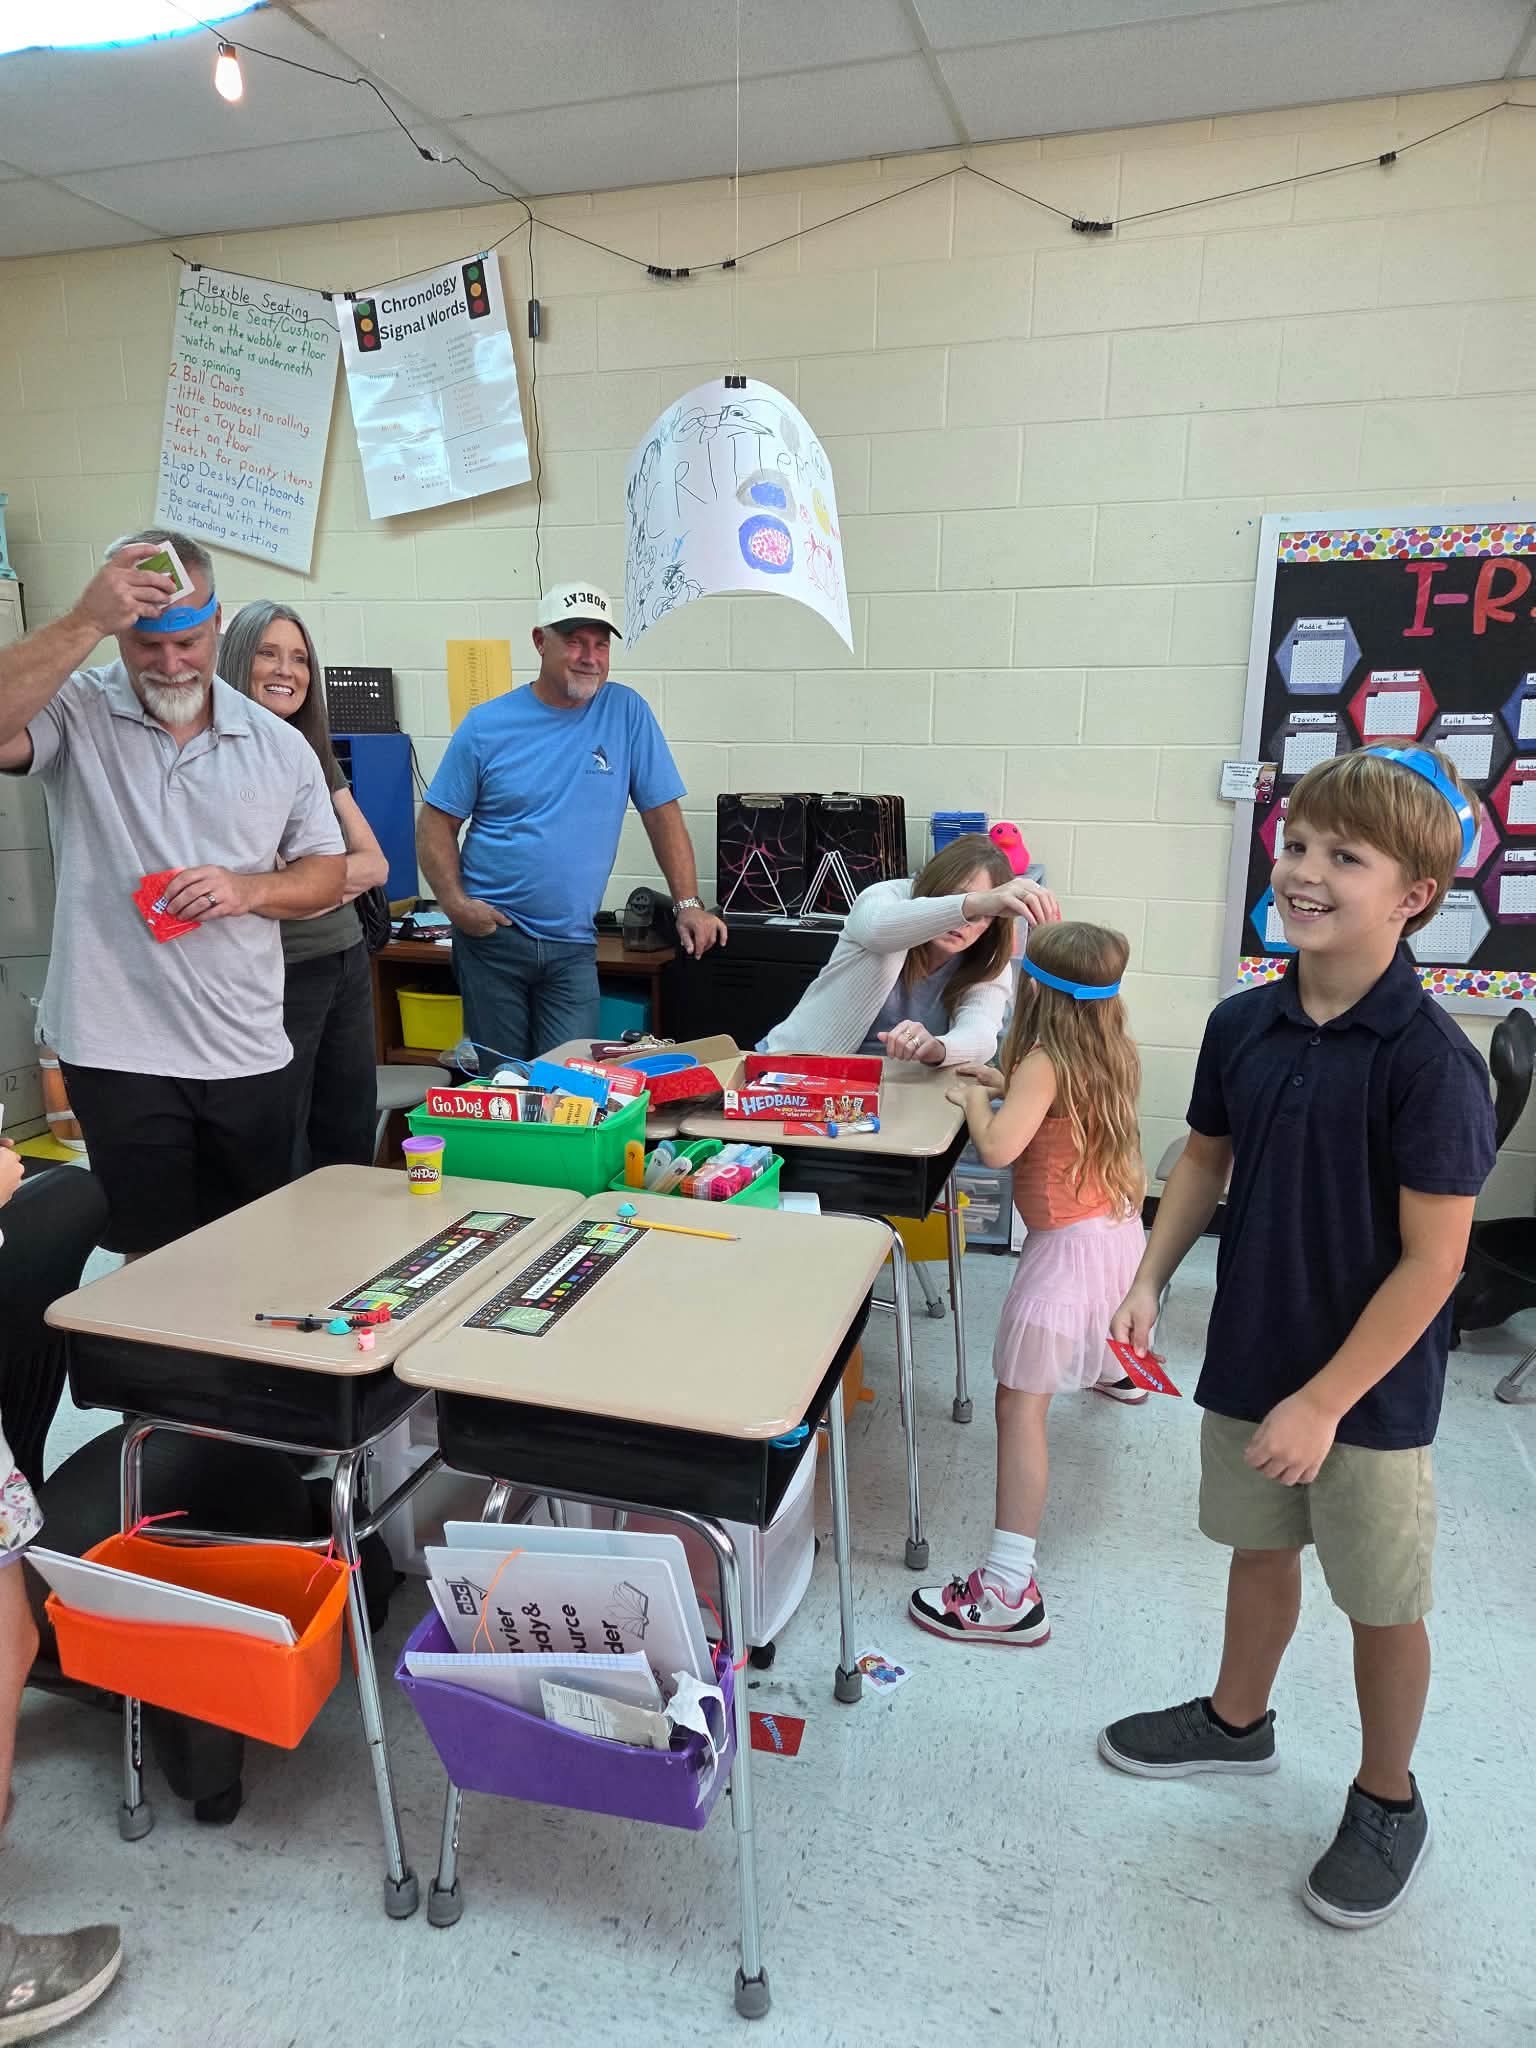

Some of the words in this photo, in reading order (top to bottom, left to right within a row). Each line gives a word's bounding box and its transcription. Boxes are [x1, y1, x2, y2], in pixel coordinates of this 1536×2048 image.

[198, 276, 250, 303] Flexible
[262, 293, 309, 323] Seating
[381, 276, 457, 314] Chronology
[193, 292, 239, 320] Wobble
[247, 308, 329, 343] Seat/Cushion
[380, 316, 426, 341] Signal
[427, 299, 466, 328] Words
[212, 325, 223, 334] on
[228, 323, 243, 338] the
[247, 330, 281, 349] wobble
[202, 359, 241, 381] spinning
[219, 340, 244, 357] what
[247, 353, 255, 361] is
[258, 352, 312, 376] underneath
[183, 365, 206, 384] Ball
[210, 374, 245, 397] Chairs
[204, 415, 210, 423] a
[214, 413, 236, 434] Toy
[238, 418, 261, 439] ball
[213, 392, 252, 416] bounces
[263, 413, 274, 424] no
[277, 413, 310, 438] rolling
[207, 433, 220, 446] on
[225, 431, 253, 453] floor
[172, 453, 195, 475] Lap
[216, 447, 232, 465] for
[240, 460, 279, 482] pointy
[283, 469, 313, 489] items
[195, 479, 234, 507] drawing
[240, 497, 256, 509] on
[186, 499, 221, 517] careful
[226, 508, 253, 526] with
[257, 517, 289, 536] them
[187, 512, 226, 538] standing
[242, 527, 279, 553] sitting
[563, 592, 607, 612] BOBCAT
[1403, 557, 1536, 637] I-R
[432, 1095, 455, 1115] Go,
[741, 1094, 808, 1116] HEDBANZ
[456, 1584, 475, 1614] abc
